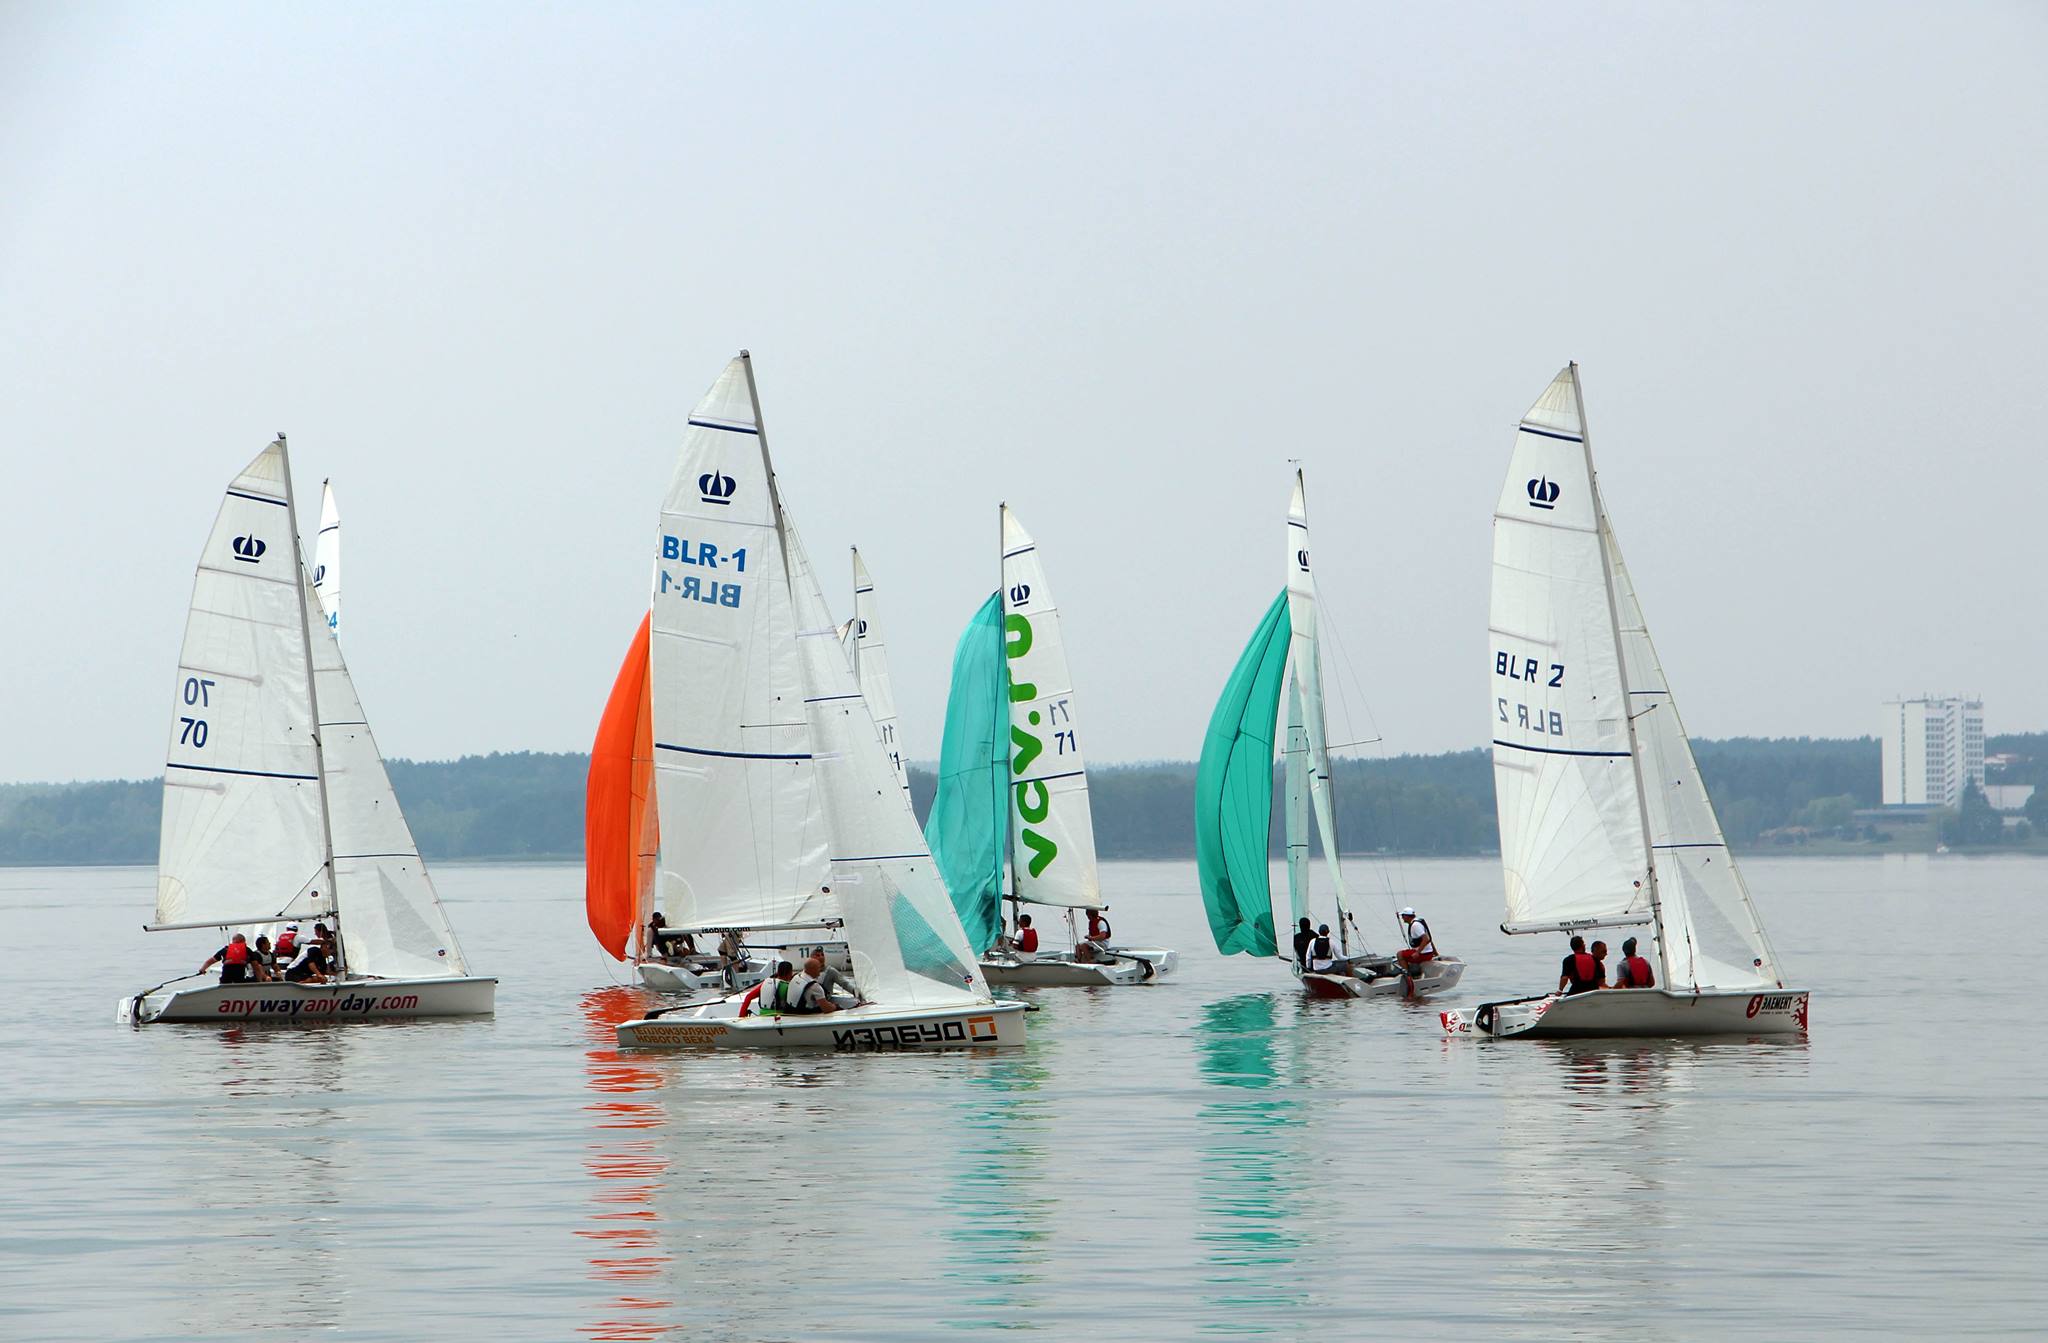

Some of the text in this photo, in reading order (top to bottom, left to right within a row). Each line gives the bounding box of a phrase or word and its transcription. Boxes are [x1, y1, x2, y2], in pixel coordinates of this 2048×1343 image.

[662, 535, 747, 572] BLR-1
[1495, 651, 1565, 687] BLR 2
[179, 717, 209, 748] 70
[1054, 730, 1077, 755] 71
[799, 947, 810, 958] 11
[217, 993, 419, 1017] anywayanyday.com
[682, 1035, 714, 1044] ВЕКА
[832, 1021, 967, 1046] ИЗОБУД
